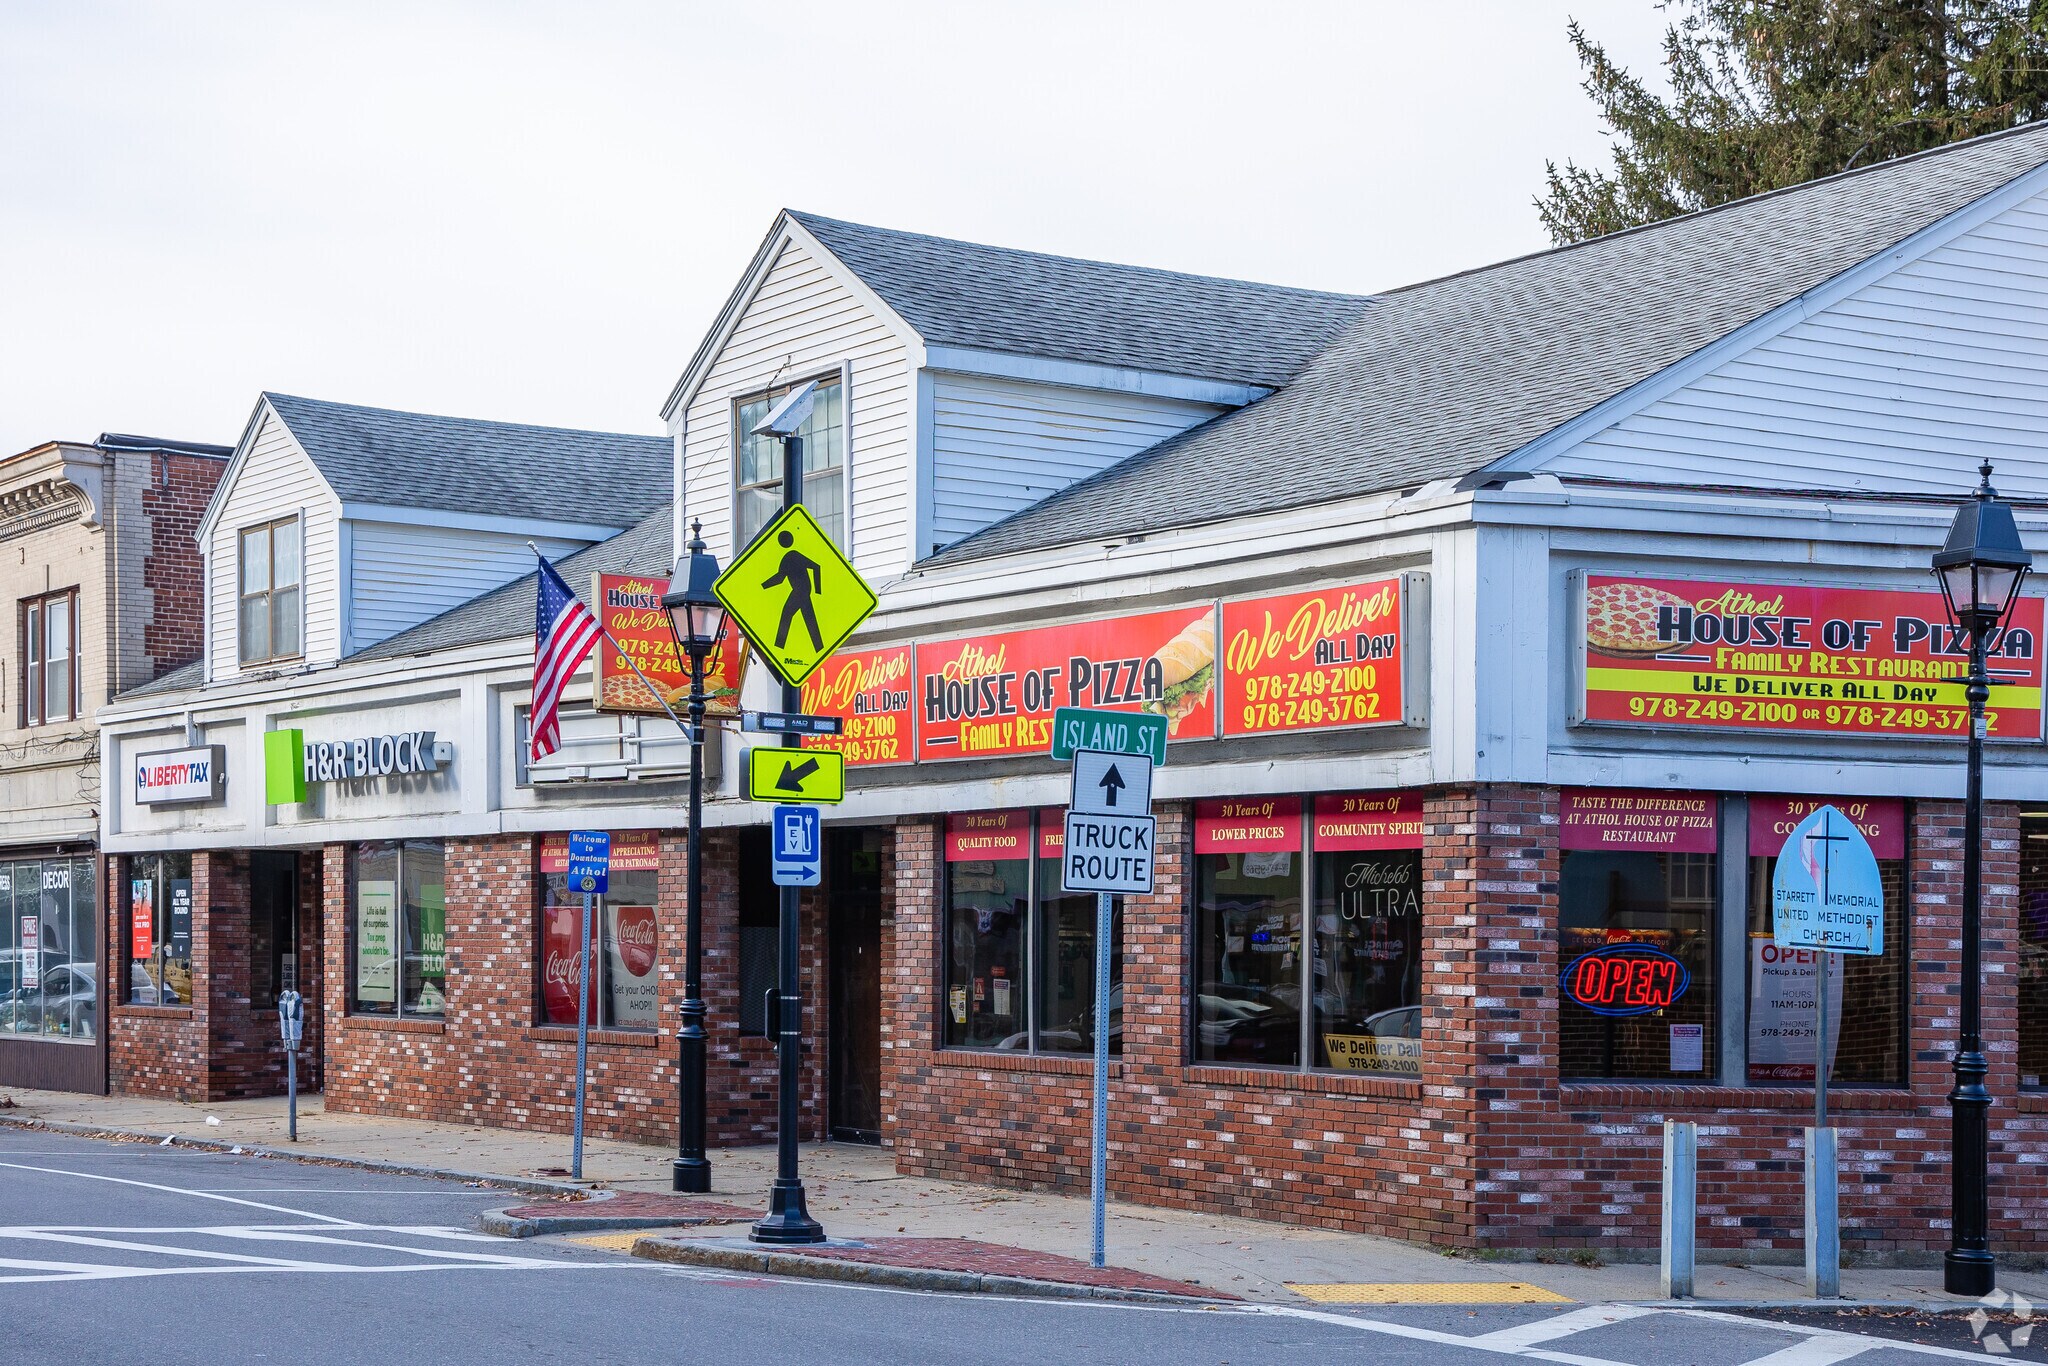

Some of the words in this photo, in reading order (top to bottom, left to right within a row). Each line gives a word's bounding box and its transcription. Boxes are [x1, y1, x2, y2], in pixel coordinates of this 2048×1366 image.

[618, 579, 654, 595] Athol
[607, 588, 660, 610] HOUSE
[1695, 588, 1784, 619] Athol
[611, 610, 640, 631] We
[1656, 605, 1811, 650] HOUSE
[1821, 619, 1883, 652] OF
[1226, 610, 1284, 675] We
[1285, 586, 1397, 661] Deliver
[1314, 638, 1353, 666] ALL
[1355, 633, 1396, 661] DAY
[615, 656, 726, 677] 978-249-362
[941, 643, 1006, 685] Athol
[1716, 647, 1803, 673] FAMILY
[1809, 652, 1969, 679] RESTAURANT
[801, 667, 834, 715] We
[834, 652, 909, 710] Deliver
[925, 672, 1018, 723] HOUSE
[1023, 666, 1062, 713] OF
[1067, 655, 1164, 708] PIZZA
[1245, 665, 1377, 702] 978-249-2100
[1693, 675, 1728, 693] WE
[1735, 676, 1834, 698] DELIVER
[1841, 682, 1885, 700] ALL
[1893, 684, 1937, 702] DAY
[854, 691, 880, 715] ALL
[881, 689, 909, 713] DAY
[1243, 693, 1380, 729] 978-249-3762
[1629, 697, 1798, 722] 978-249-2100
[1802, 708, 1820, 720] OR
[1825, 704, 1999, 731] 978-249-372
[960, 721, 1012, 751] FAMILY
[1061, 720, 1128, 751] ISLAND
[1136, 726, 1158, 755] ST
[304, 741, 349, 782] H&R
[353, 731, 428, 777] BLOCK
[1221, 804, 1233, 817] 30
[1235, 804, 1260, 816] Years
[1262, 802, 1275, 819] Of
[1343, 799, 1355, 812] 30
[1357, 798, 1385, 811] Years
[1387, 796, 1401, 815] Of
[1572, 797, 1606, 809] TASTE
[1610, 798, 1633, 810] THE
[1635, 799, 1706, 812] DIFFERENCE
[1785, 802, 1804, 815] 30
[1850, 803, 1868, 820] Of
[966, 816, 975, 828] 30
[977, 816, 996, 827] Years
[998, 814, 1008, 829] Of
[1318, 822, 1386, 837] COMMUNITY
[1565, 813, 1582, 825] AT
[1583, 813, 1621, 826] ATHOL
[1623, 815, 1662, 827] HOUSE
[1664, 815, 1680, 828] OF
[1682, 816, 1713, 829] PIZZA
[572, 834, 607, 844] Welcome
[626, 833, 641, 842] Years
[642, 832, 650, 844] Of
[1045, 834, 1064, 846] FRIE
[1072, 823, 1149, 851] TRUCK
[1212, 827, 1247, 841] LOWER
[1248, 826, 1285, 839] PRICES
[1602, 830, 1677, 843] RESTAURANT
[548, 848, 562, 856] ATHOL
[612, 846, 655, 856] APPRECIATING
[957, 837, 992, 852] QUALITY
[994, 836, 1017, 847] FOOD
[570, 853, 608, 863] Downtown
[608, 859, 625, 868] YOUR
[571, 866, 606, 876] Athol
[1071, 855, 1146, 882] ROUTE
[1344, 862, 1413, 888] Michelob
[42, 870, 69, 889] DECOR
[175, 889, 187, 898] OPEN
[1776, 889, 1815, 903] STARRETT
[1829, 894, 1879, 908] MEMORIAL
[174, 907, 188, 915] ROUND
[366, 906, 374, 915] Life
[1341, 888, 1420, 920] ULTRA
[1777, 908, 1809, 921] UNITED
[1817, 911, 1879, 926] METHODIST
[366, 933, 375, 942] Tax
[619, 919, 656, 945] Coca-Cola
[1803, 929, 1851, 943] CHURCH
[422, 933, 444, 951] H&R
[1575, 957, 1677, 1006] OPEN
[1762, 968, 1790, 977] Pickup
[1791, 968, 1798, 976] &
[614, 984, 624, 995] Get
[625, 986, 639, 997] your
[1782, 990, 1812, 999] HOURS
[1770, 1000, 1817, 1009] 11AM-10P
[1760, 1028, 1817, 1037] 978-249-21
[1780, 1020, 1810, 1028] PHONE
[1328, 1039, 1346, 1054] We
[1349, 1040, 1393, 1056] Deliver
[1396, 1042, 1422, 1058] Dail
[1348, 1057, 1419, 1072] 978-249-2100
